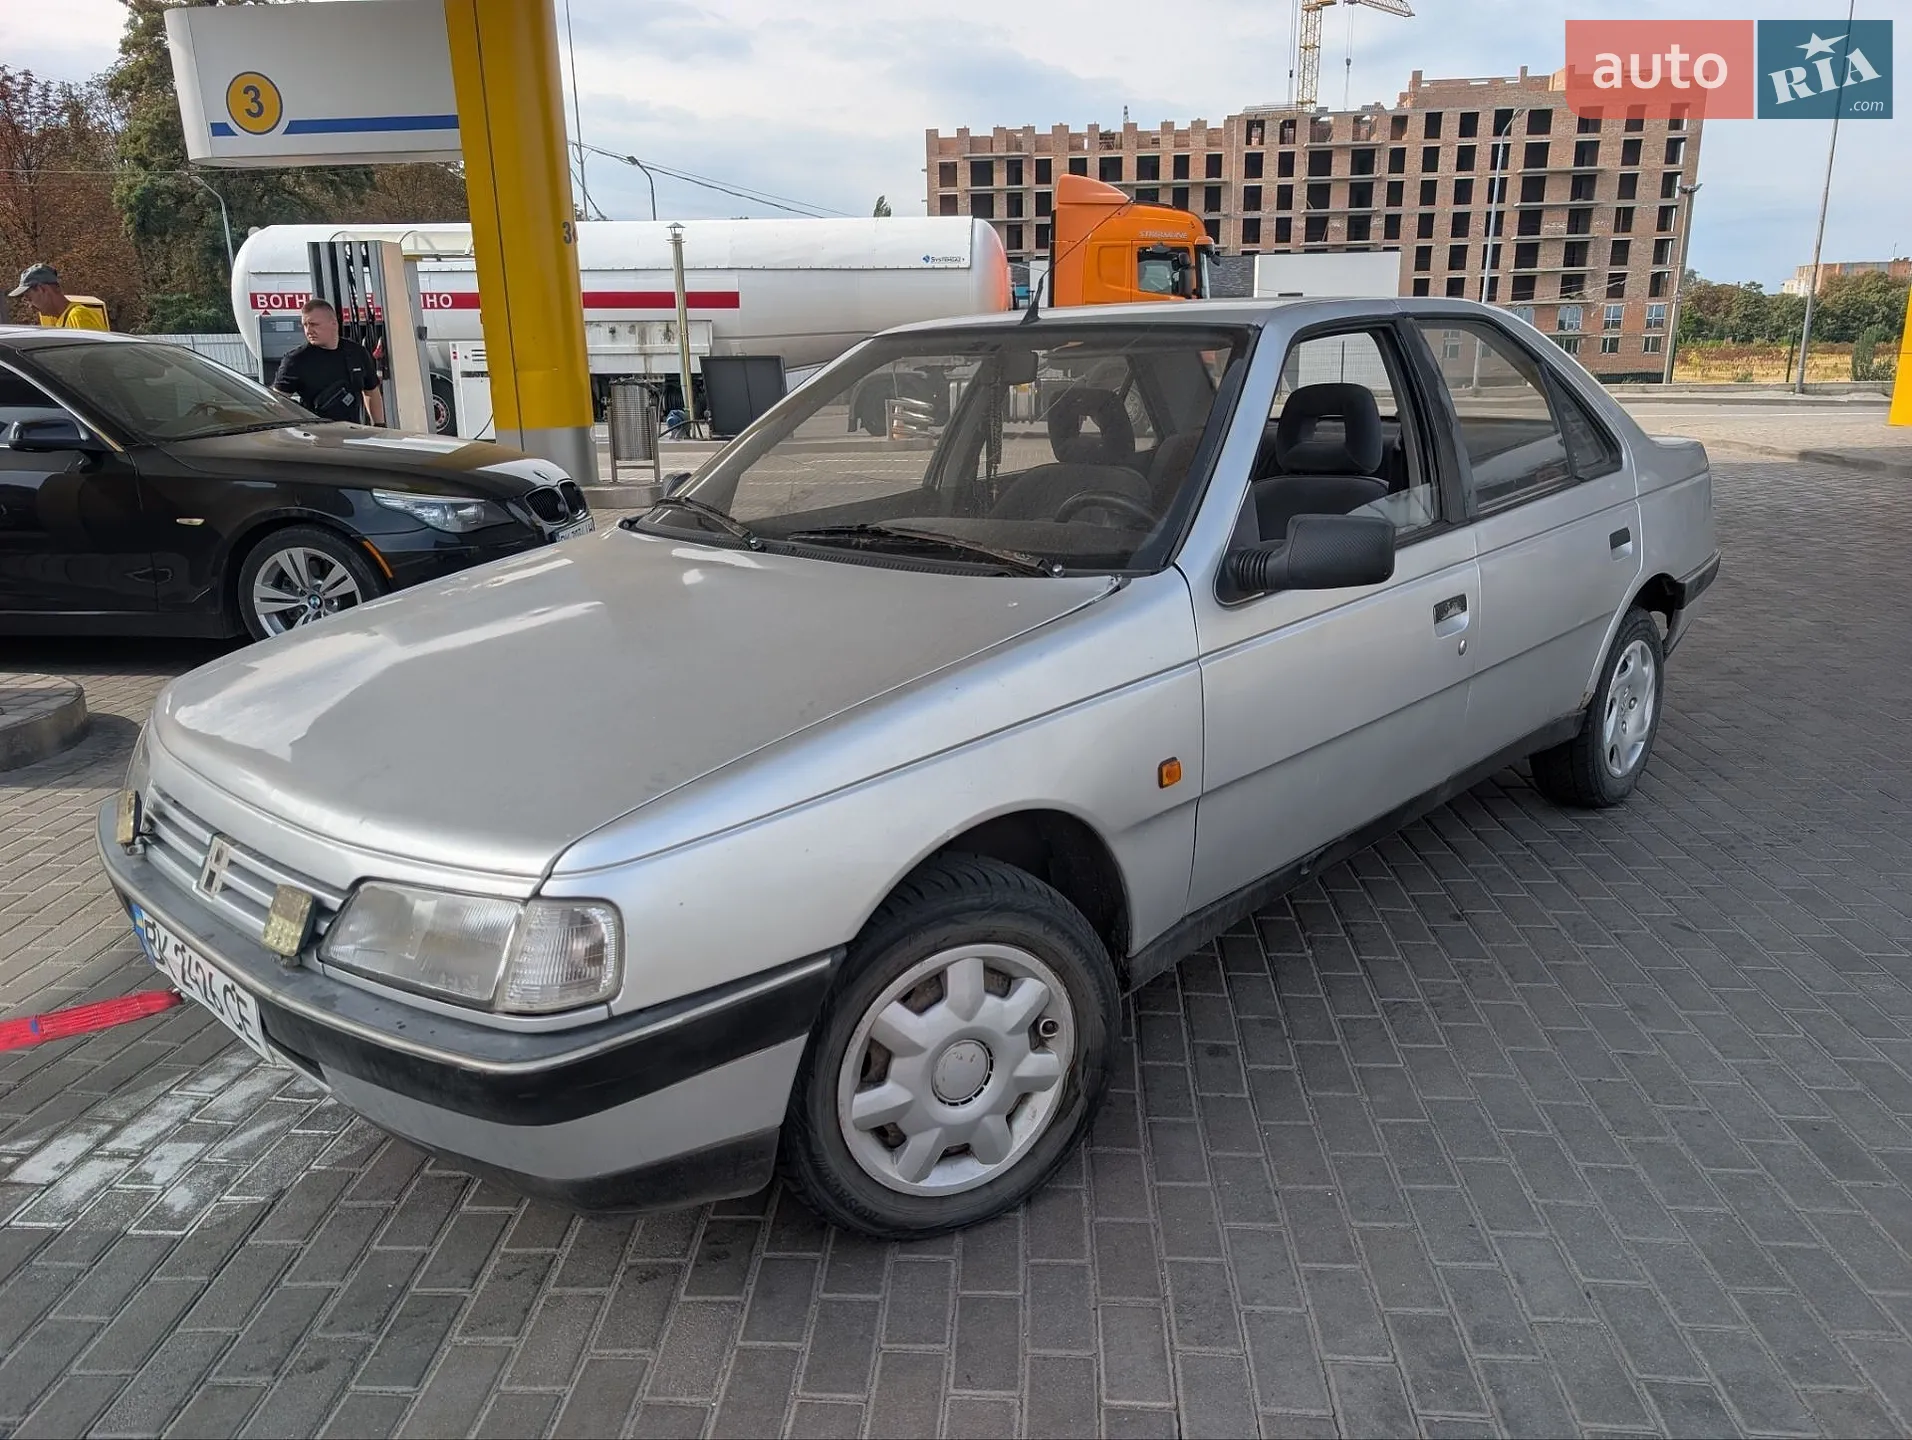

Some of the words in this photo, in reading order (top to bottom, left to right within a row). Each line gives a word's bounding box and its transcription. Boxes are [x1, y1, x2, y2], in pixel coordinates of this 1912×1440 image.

[243, 85, 264, 118] 3
[174, 943, 225, 1016] 2426
[222, 983, 261, 1048] CE
